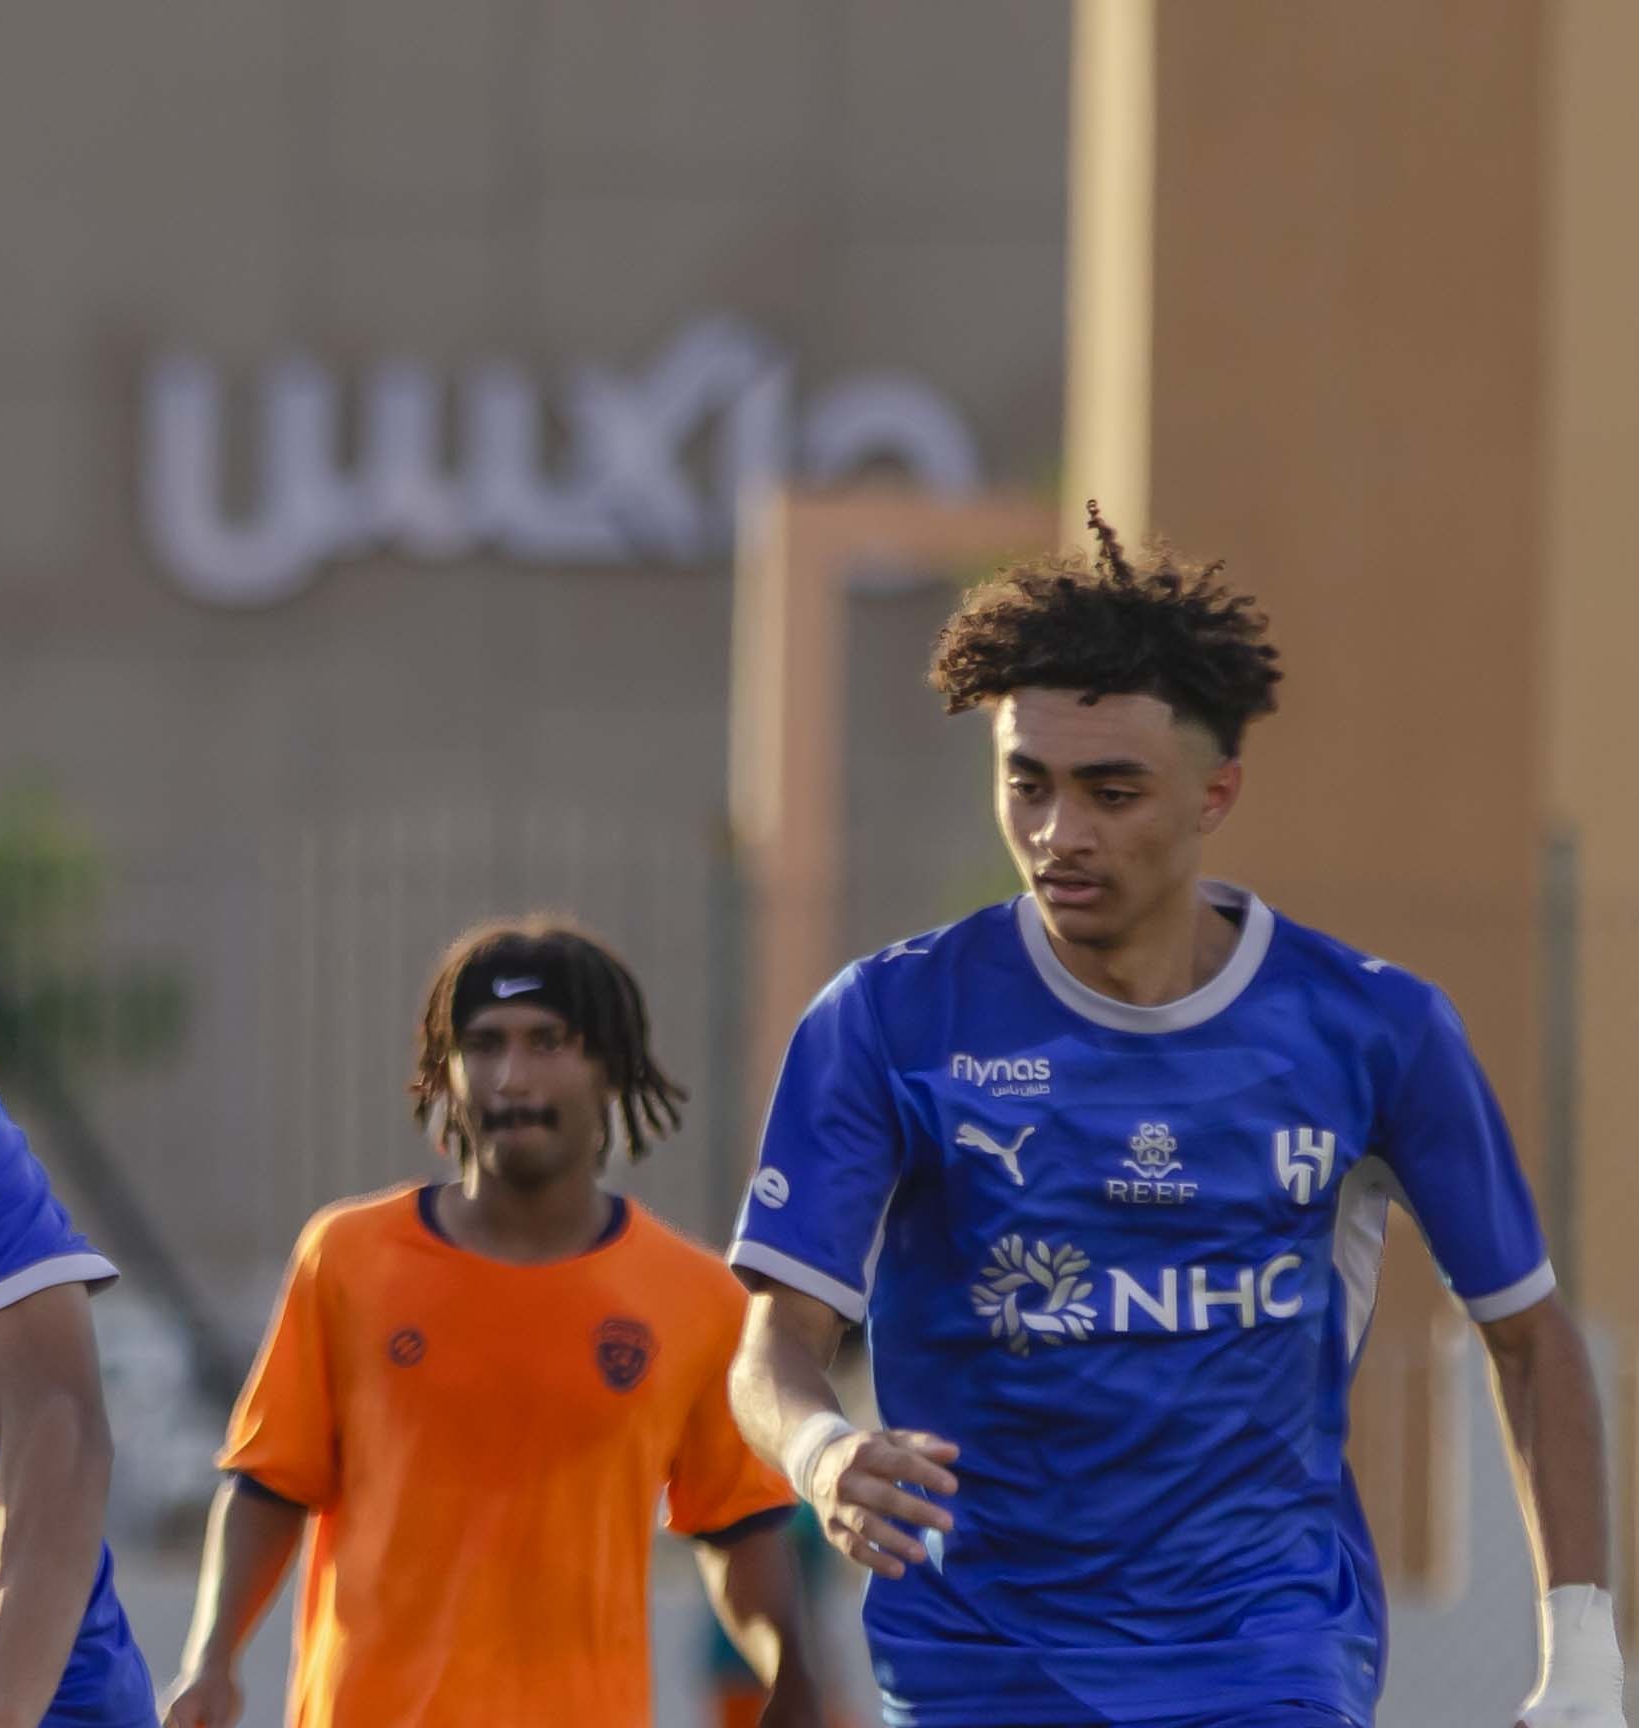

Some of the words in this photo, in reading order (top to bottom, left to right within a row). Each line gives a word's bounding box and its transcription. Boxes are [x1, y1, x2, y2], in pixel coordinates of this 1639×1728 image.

[951, 1053, 1051, 1088] flynas
[1106, 1179, 1199, 1204] REEF
[1106, 1254, 1303, 1333] NHC
